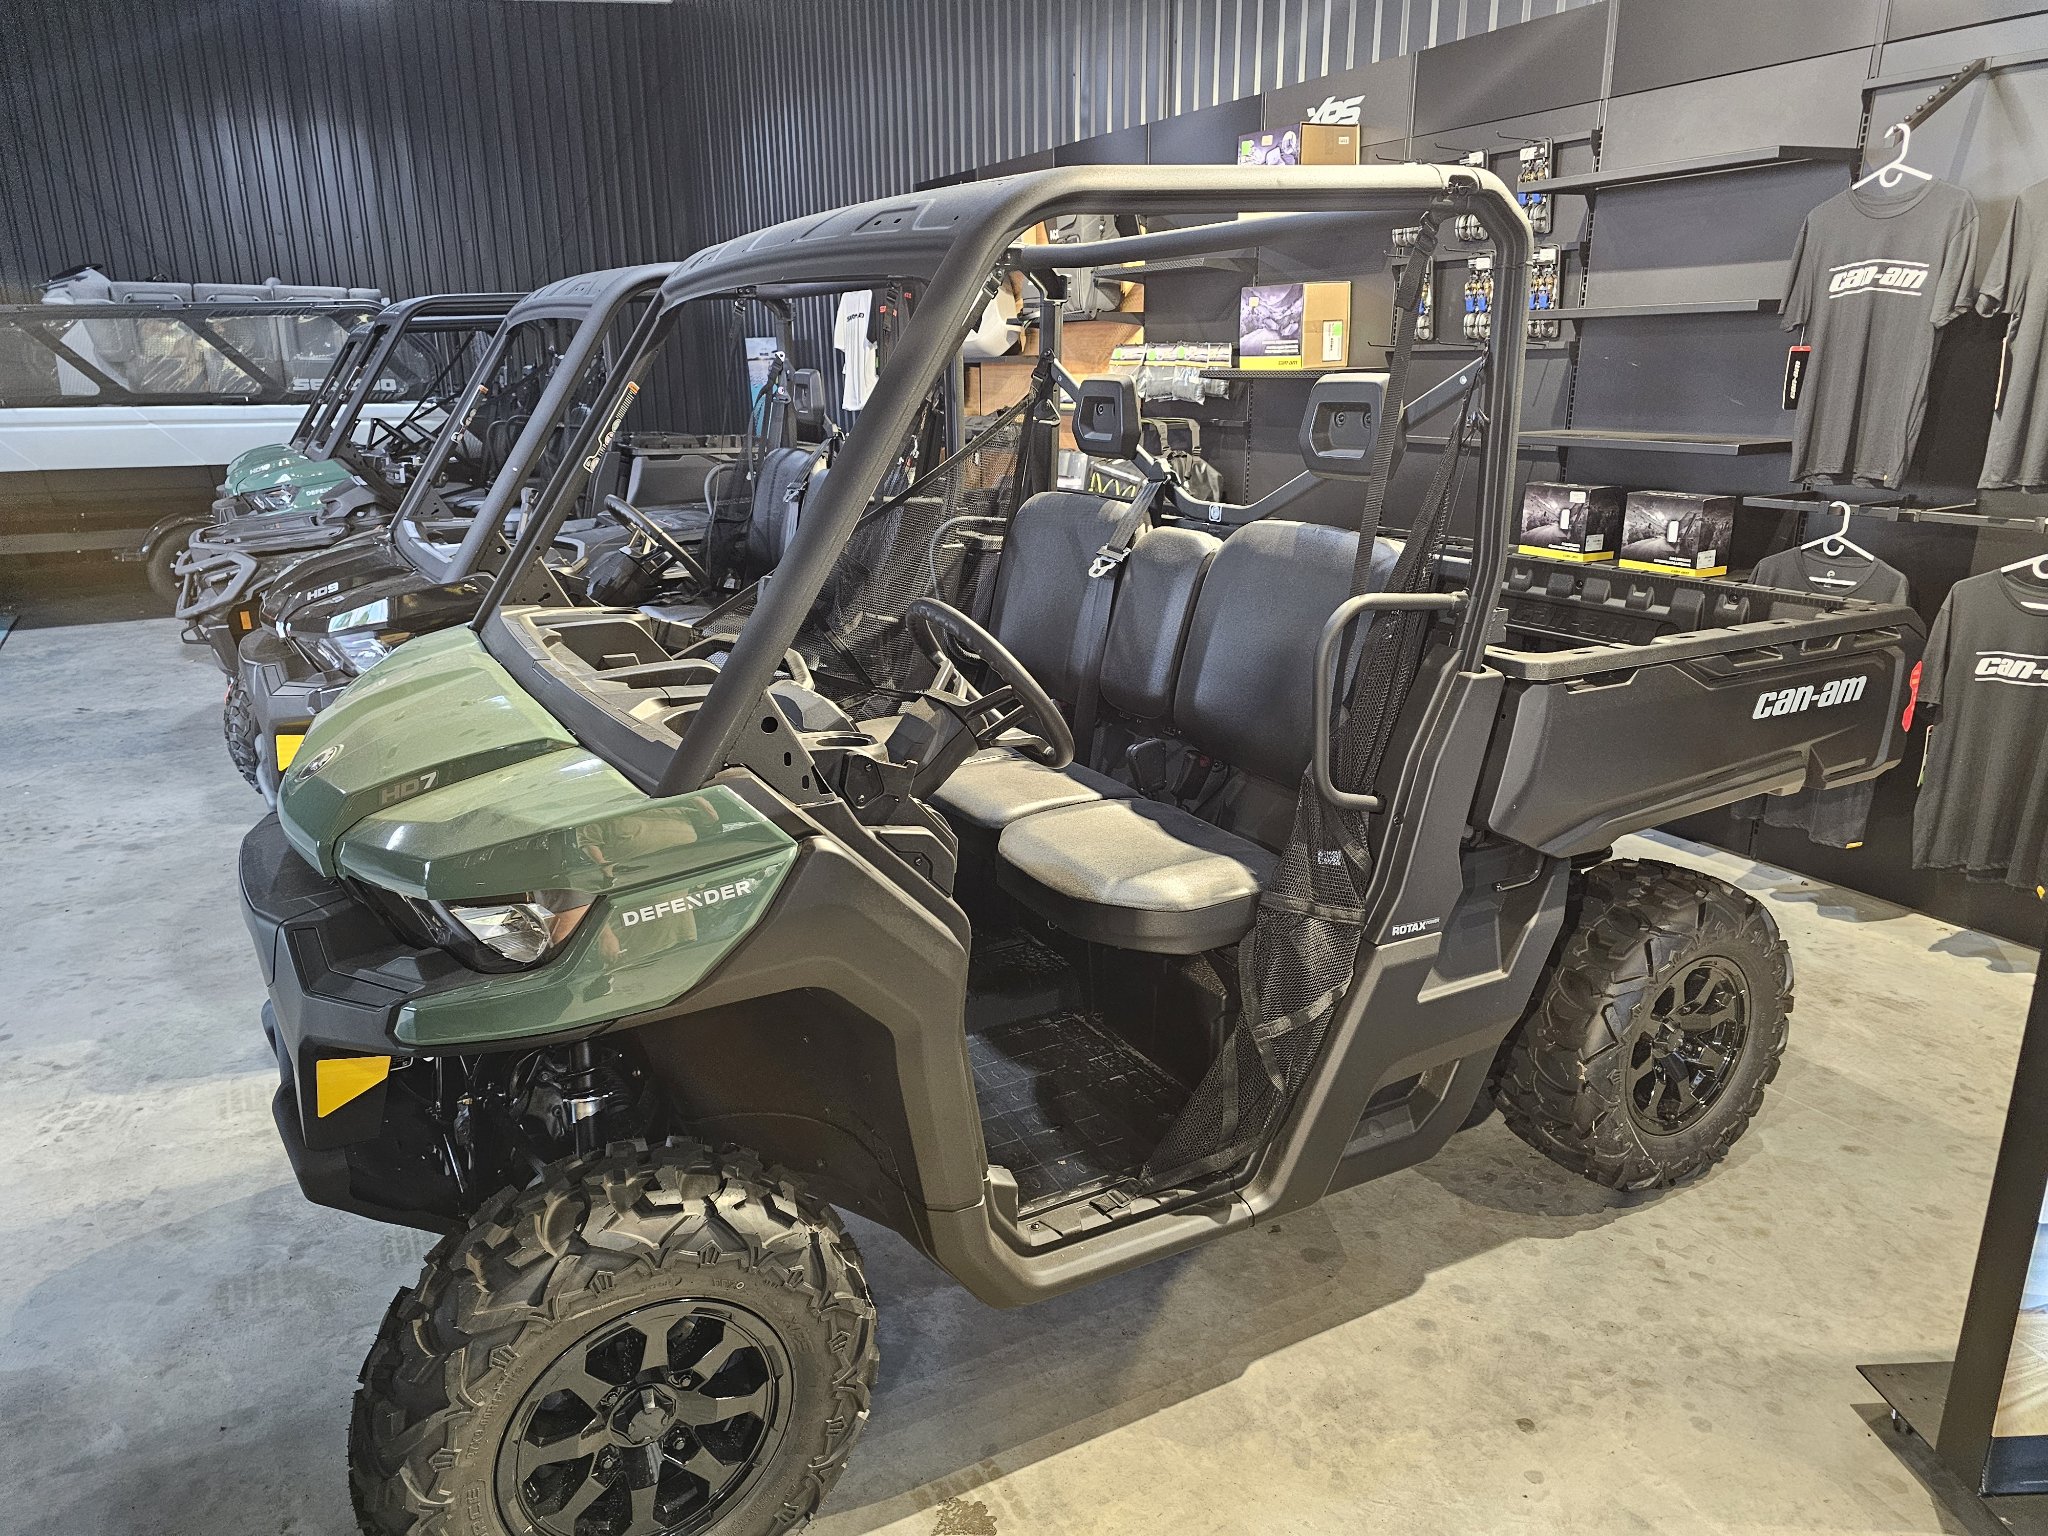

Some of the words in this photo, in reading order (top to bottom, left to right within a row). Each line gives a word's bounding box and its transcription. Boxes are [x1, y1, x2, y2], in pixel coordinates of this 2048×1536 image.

[1828, 266, 1929, 293] can-am
[1752, 675, 1868, 720] can-am
[381, 771, 437, 806] HD7
[622, 879, 753, 927] DEFENDER
[1391, 921, 1427, 937] ROTAX
